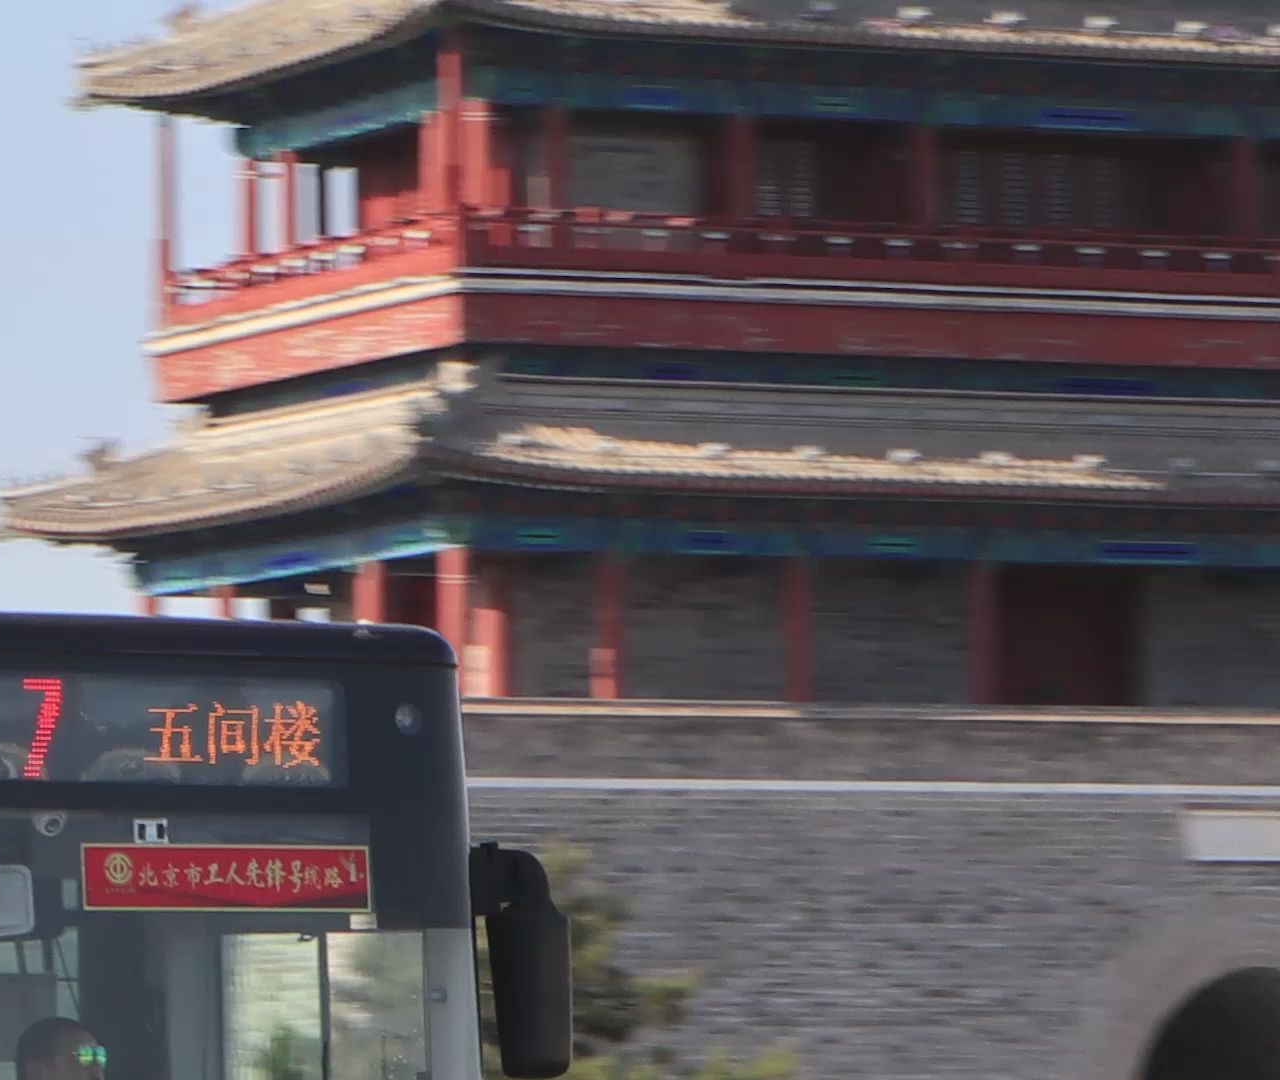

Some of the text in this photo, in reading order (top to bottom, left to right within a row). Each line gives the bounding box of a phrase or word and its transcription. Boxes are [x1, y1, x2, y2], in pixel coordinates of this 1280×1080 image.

[23, 677, 63, 778] 7
[143, 700, 321, 769] 五间楼
